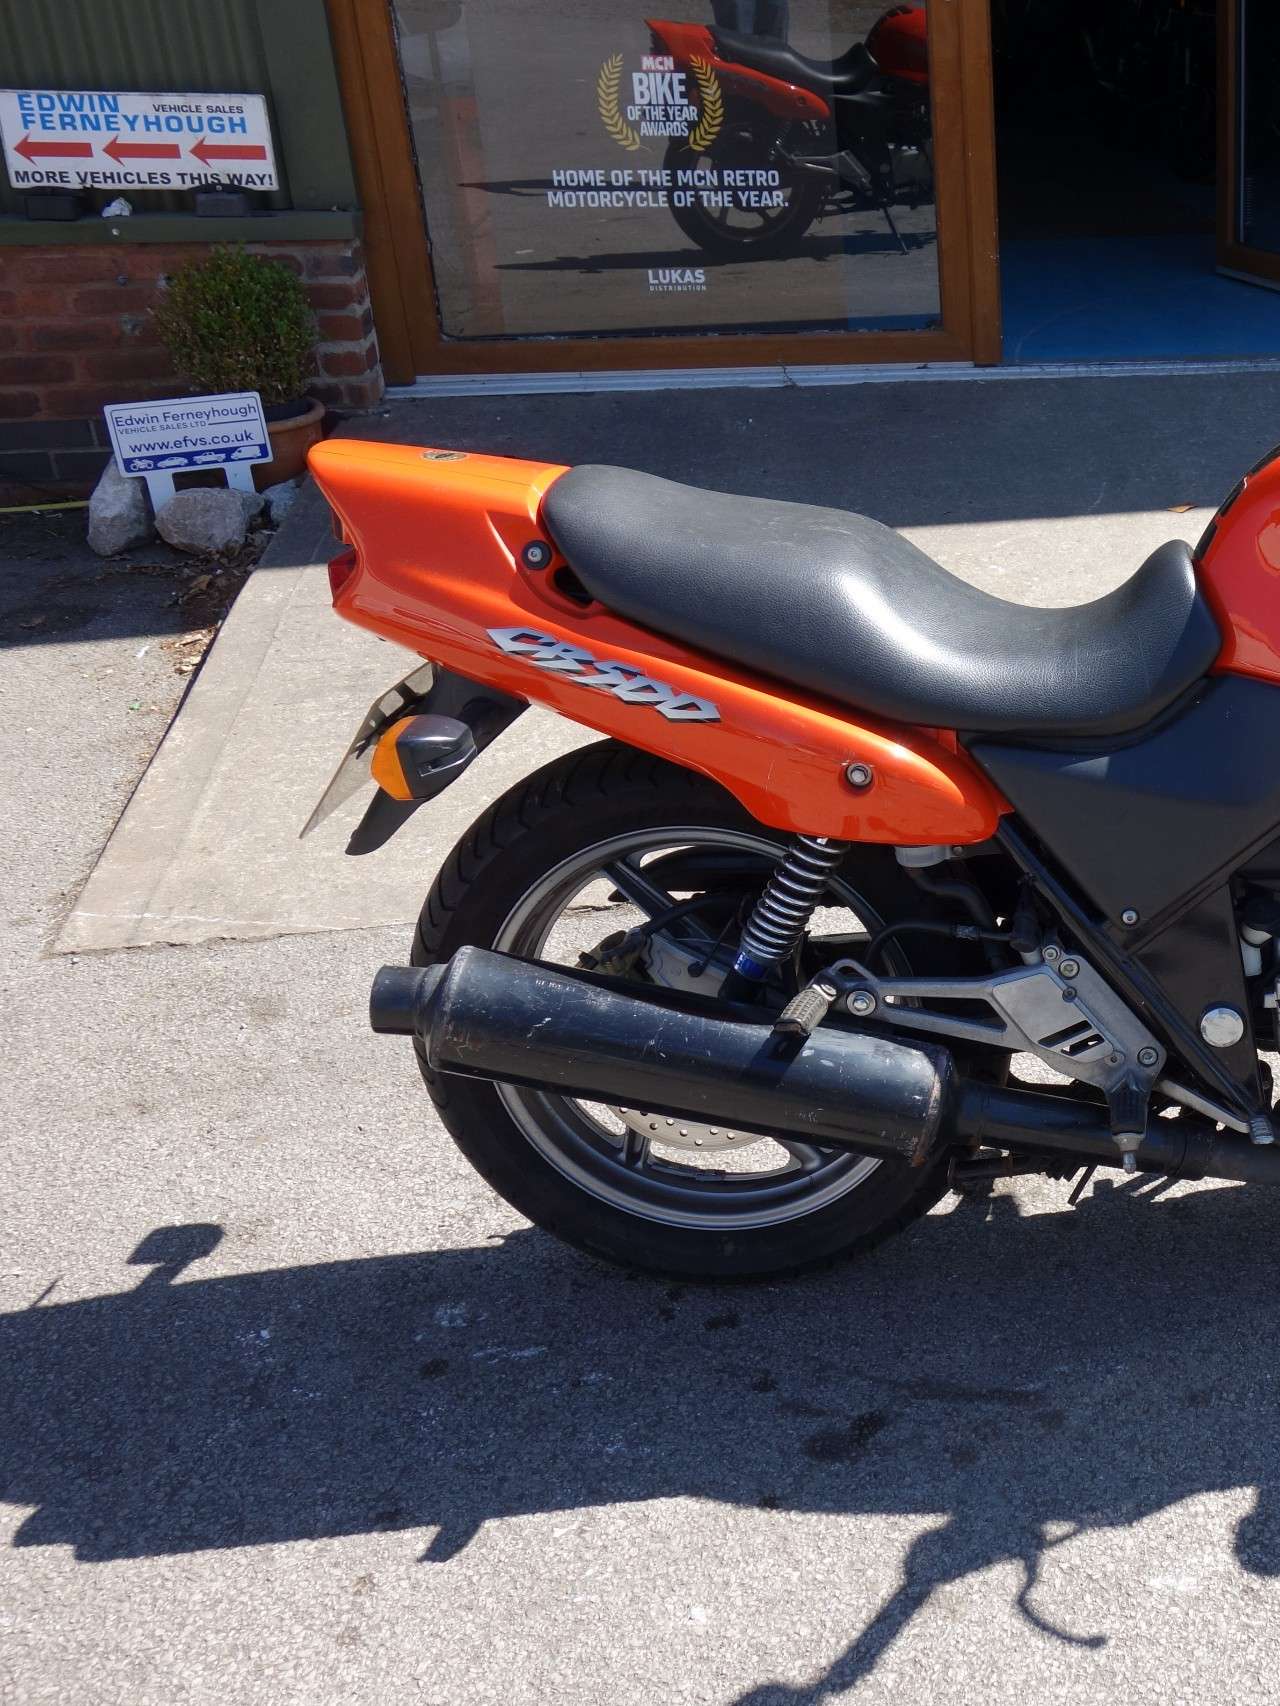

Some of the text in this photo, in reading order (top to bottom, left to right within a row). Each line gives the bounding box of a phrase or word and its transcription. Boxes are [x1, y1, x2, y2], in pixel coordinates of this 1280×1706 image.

[641, 56, 675, 70] MCN
[632, 72, 688, 105] BIKE
[17, 93, 120, 113] EDWIN
[152, 104, 244, 114] VEHICLE SALES
[627, 105, 698, 121] OF THE YEAR
[21, 112, 247, 134] FERNEYHOUGH
[640, 121, 689, 137] AWARDS
[14, 170, 274, 187] MORE VEHICLES THIS WAY!
[552, 169, 780, 187] HOME OF THE MCN RETRO
[547, 190, 790, 208] MOTORCYCLE OF THE YEAR.
[648, 269, 706, 284] LUKAS
[115, 404, 257, 427] Edwin Ferneyhough
[118, 420, 206, 435] VEHICLE SALES LTD
[129, 430, 254, 453] www.efvs.co.uk
